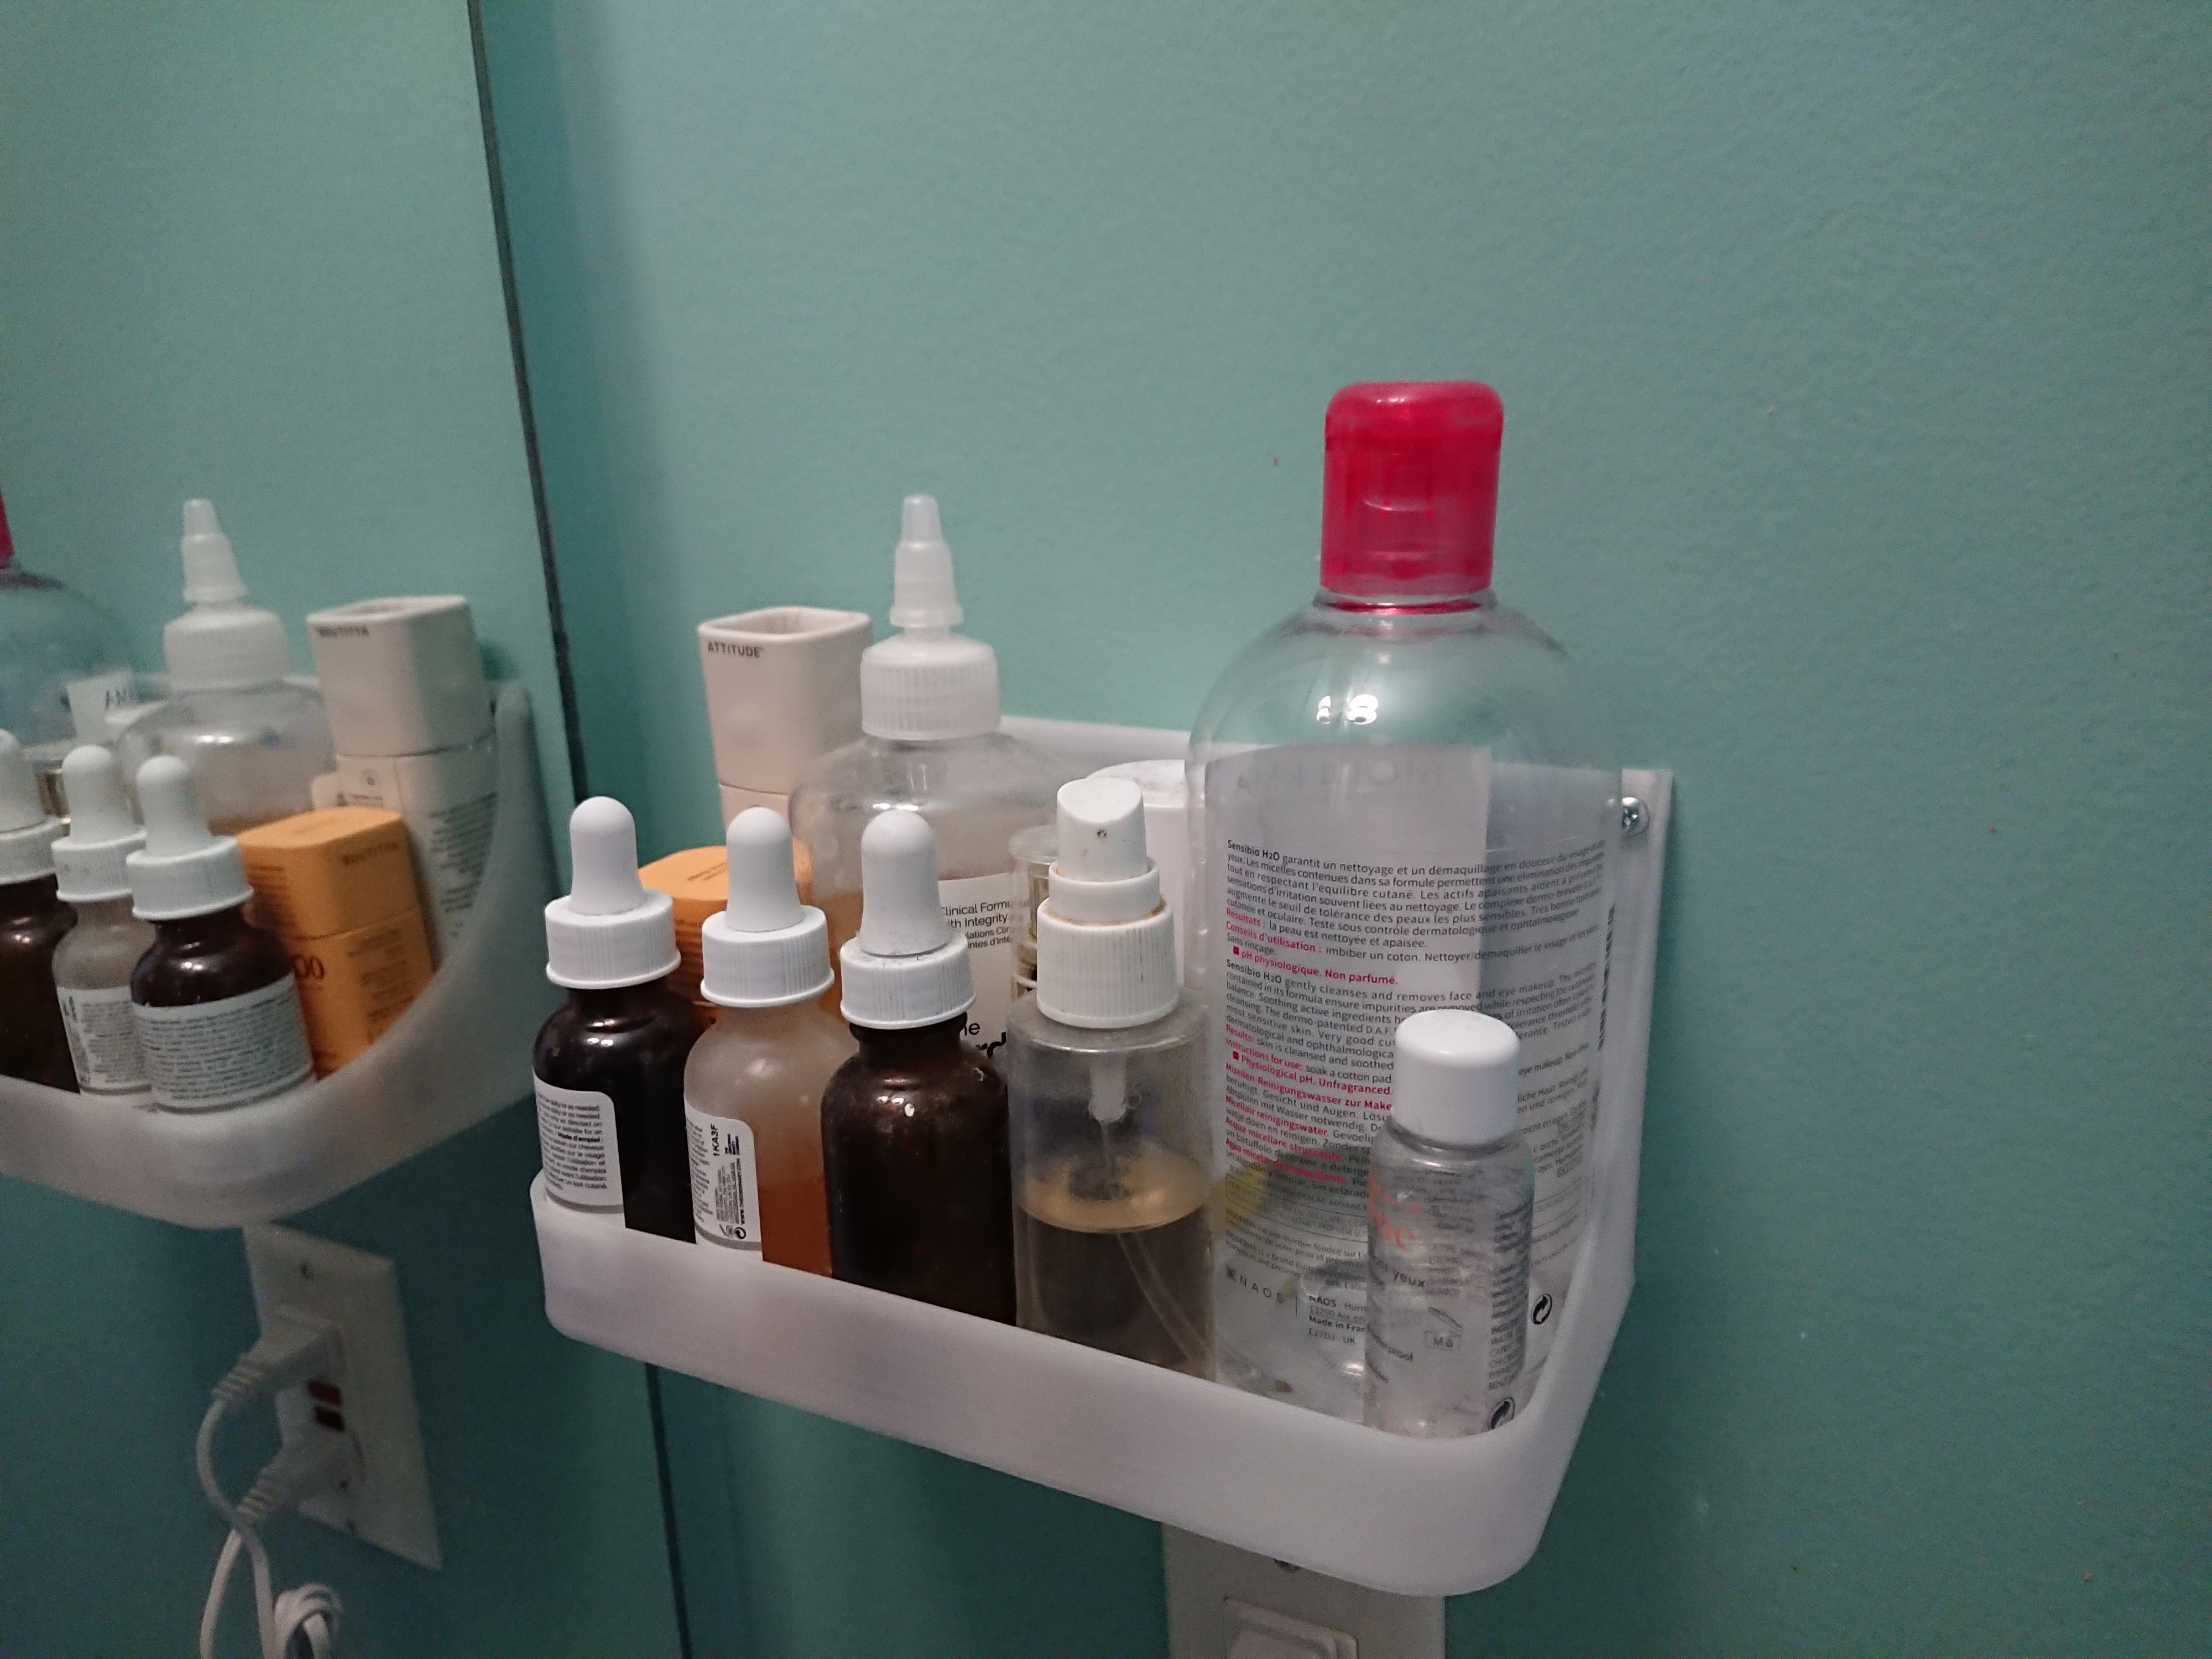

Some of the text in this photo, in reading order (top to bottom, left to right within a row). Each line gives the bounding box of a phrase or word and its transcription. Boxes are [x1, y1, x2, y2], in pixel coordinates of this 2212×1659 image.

[707, 641, 761, 658] ATTITUDE
[1228, 839, 1259, 857] Sensibio
[1282, 855, 1320, 868] garantit
[1323, 862, 1336, 870] un
[1340, 863, 1394, 877] nettoyage
[1397, 867, 1408, 875] et
[1519, 857, 1554, 869] douceur
[1557, 853, 1567, 862] du
[1246, 857, 1259, 868] Les
[1261, 863, 1296, 875] micelles
[1298, 869, 1348, 884] contenues
[1351, 875, 1376, 885] dans
[1393, 877, 1434, 887] formule
[1437, 877, 1495, 888] permettent
[1498, 874, 1514, 883] une
[1227, 875, 1266, 894] sensations
[1268, 886, 1317, 903] d'irritation
[1319, 897, 1360, 909] souvent
[1406, 902, 1461, 914] nettoyage.
[1464, 901, 1475, 910] Le
[1478, 898, 1525, 911] complexe
[1228, 864, 1243, 875] tout
[1245, 870, 1254, 878] en
[1258, 874, 1309, 890] respectant
[1421, 890, 1439, 899] Les
[1443, 889, 1474, 899] actifs
[1478, 884, 1528, 899] apaisants
[1531, 879, 1559, 890] aident
[1227, 888, 1266, 904] augmente
[1268, 897, 1276, 907] le
[1279, 901, 1301, 912] seuil
[1304, 905, 1316, 914] de
[1373, 914, 1393, 922] des
[1396, 915, 1430, 925] peaux
[1434, 914, 1449, 923] les
[1452, 912, 1475, 925] plus
[1551, 898, 1574, 911] bonne
[1257, 907, 1265, 915] et
[1267, 911, 1306, 925] oculaire.
[1338, 924, 1361, 932] sous
[1412, 924, 1498, 937] dermatologique
[1226, 921, 1257, 939] Conseils
[1326, 946, 1366, 958] imbiber
[1387, 952, 1421, 961] coton.
[1227, 932, 1243, 946] Sans
[1269, 920, 1276, 930] la
[1279, 925, 1301, 936] peau
[1304, 930, 1318, 938] est
[1370, 936, 1379, 946] et
[1227, 958, 1261, 978] Sensibio
[1285, 979, 1316, 993] gently
[1319, 985, 1368, 999] cleanses
[1371, 991, 1392, 1001] and
[1397, 992, 1446, 1001] removes
[1449, 991, 1472, 1000] face
[1475, 990, 1495, 1000] and
[1499, 988, 1516, 998] eye
[1559, 973, 1572, 983] The
[1241, 950, 1398, 985] pH physiologique. Non parfumé.
[1227, 972, 1262, 989] contained
[1274, 988, 1284, 996] its
[1286, 988, 1323, 1004] formula
[1325, 999, 1359, 1009] ensure
[1363, 1004, 1416, 1014] impurities
[1483, 1000, 1510, 1011] while
[1512, 990, 1554, 1007] respecting
[1259, 993, 1298, 1012] Soothing
[1301, 1006, 1329, 1016] active
[1332, 1011, 1391, 1024] ingredients
[1516, 1002, 1552, 1018] irritation
[1227, 1004, 1244, 1018] most
[1248, 1013, 1287, 1030] sensitive
[1291, 1026, 1313, 1036] skin.
[1318, 1030, 1342, 1044] Very
[1346, 1037, 1374, 1047] good
[1266, 1006, 1281, 1018] The
[1227, 1014, 1304, 1046] dermatological and
[1226, 1038, 1269, 1061] Instructions
[1271, 1055, 1283, 1065] for
[1306, 1064, 1327, 1075] soak
[1337, 1071, 1369, 1081] cotton
[1372, 1074, 1392, 1084] pad
[1256, 1037, 1272, 1049] skin
[1284, 1046, 1326, 1062] cleansed
[1329, 1056, 1347, 1065] and
[1241, 1055, 1297, 1080] Physiological
[1225, 1095, 1255, 1115] Micellair
[1261, 1099, 1274, 1109] mit
[1277, 1106, 1308, 1121] Wasser
[1262, 1089, 1297, 1107] Gesicht
[1301, 1102, 1319, 1112] und
[1344, 1099, 1361, 1108] zur
[1225, 1117, 1287, 1149] Acqua micellare
[1226, 1108, 1245, 1122] watje
[1245, 1117, 1265, 1130] doen
[1268, 1125, 1278, 1133] en
[1323, 1139, 1358, 1152] Zonder
[1309, 1314, 1344, 1329] Made in
